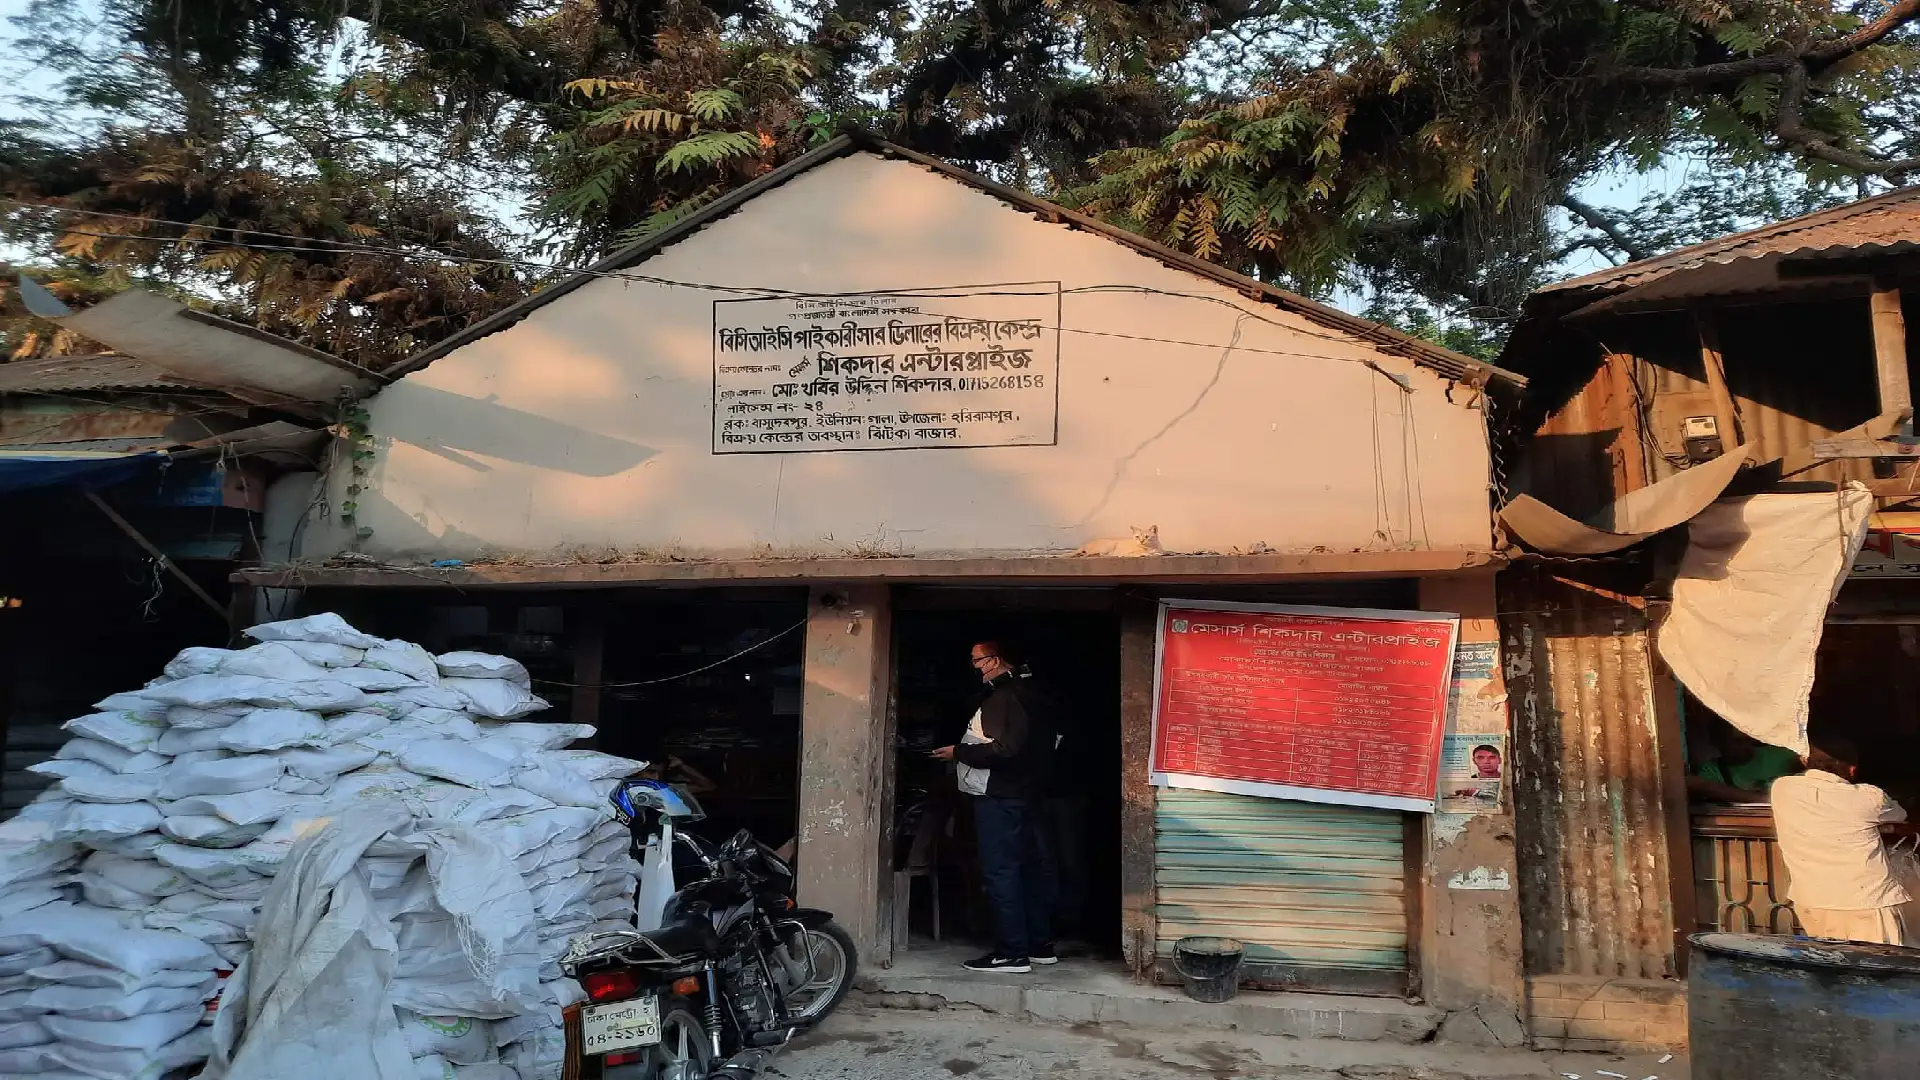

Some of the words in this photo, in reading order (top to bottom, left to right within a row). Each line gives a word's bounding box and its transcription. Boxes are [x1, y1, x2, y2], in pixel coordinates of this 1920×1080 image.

[719, 325, 793, 353] বিসিআইসি
[888, 319, 942, 346] ডিলারের
[944, 316, 991, 342] বিক্রয়
[993, 318, 1042, 340] কেন্দ্র
[817, 350, 895, 376] শিকদার
[772, 383, 798, 398] মোঃ
[722, 431, 756, 445] বিক্রয়
[759, 430, 804, 444] কেন্দ্রের
[1191, 622, 1246, 637] মেসার্স
[1253, 623, 1324, 641] শিকদার
[1330, 630, 1441, 649] এন্টারপ্রাইজ
[587, 1012, 608, 1023] ঢাকা
